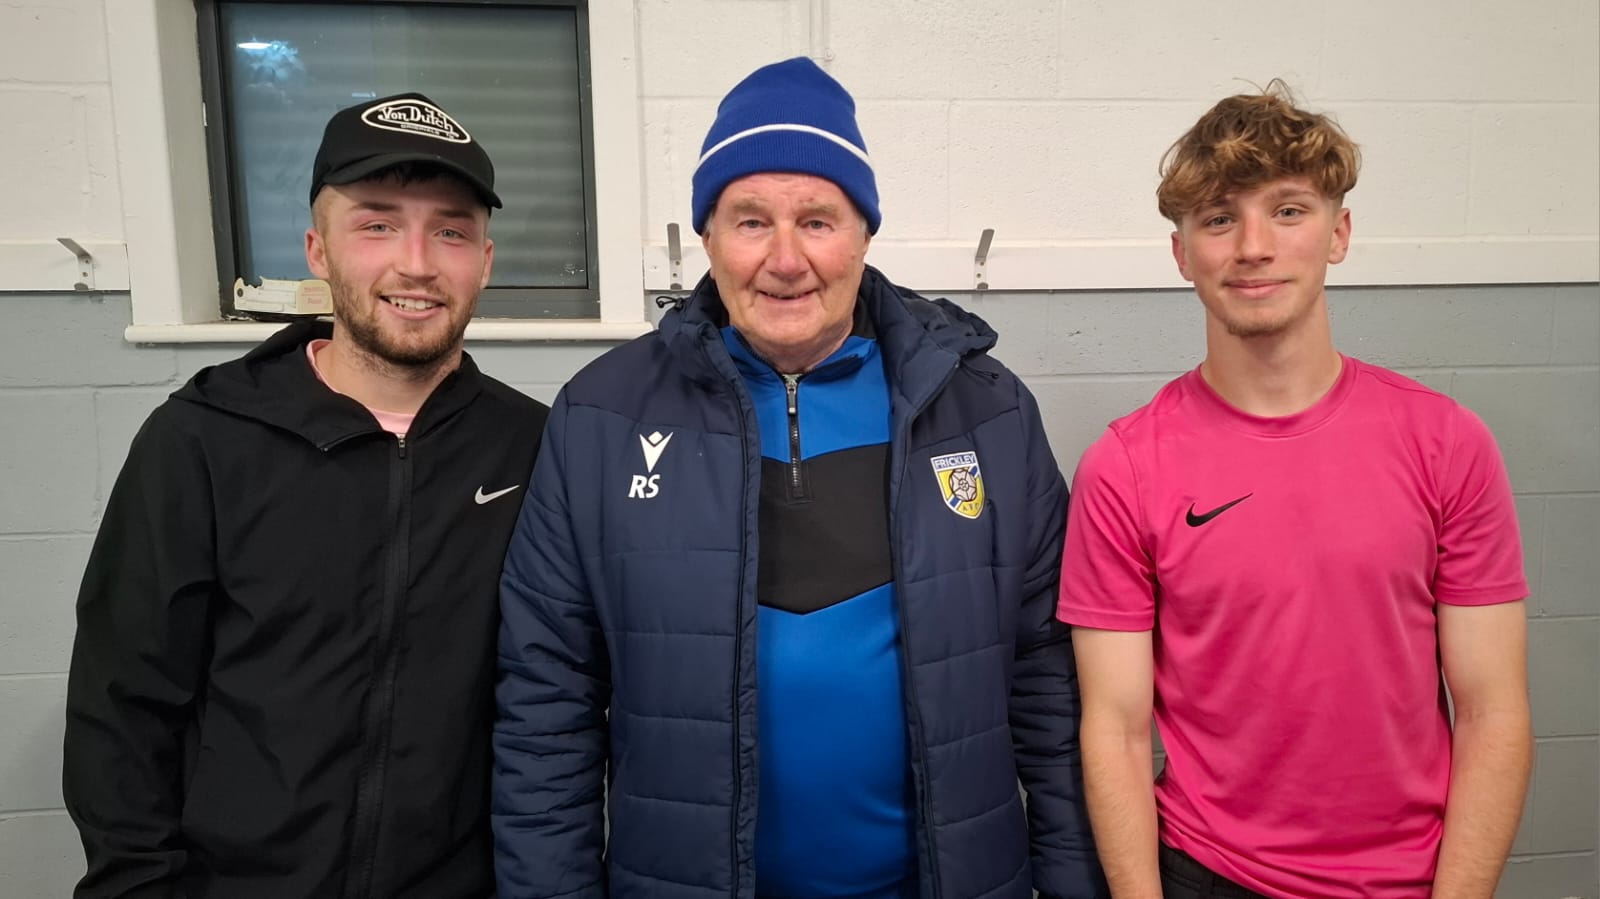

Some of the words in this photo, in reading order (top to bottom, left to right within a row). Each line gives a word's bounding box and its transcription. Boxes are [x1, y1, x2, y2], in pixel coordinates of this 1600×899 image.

[378, 106, 409, 122] Von
[409, 106, 455, 133] Dutch
[935, 454, 976, 470] FRICKLEY
[628, 474, 661, 499] RS
